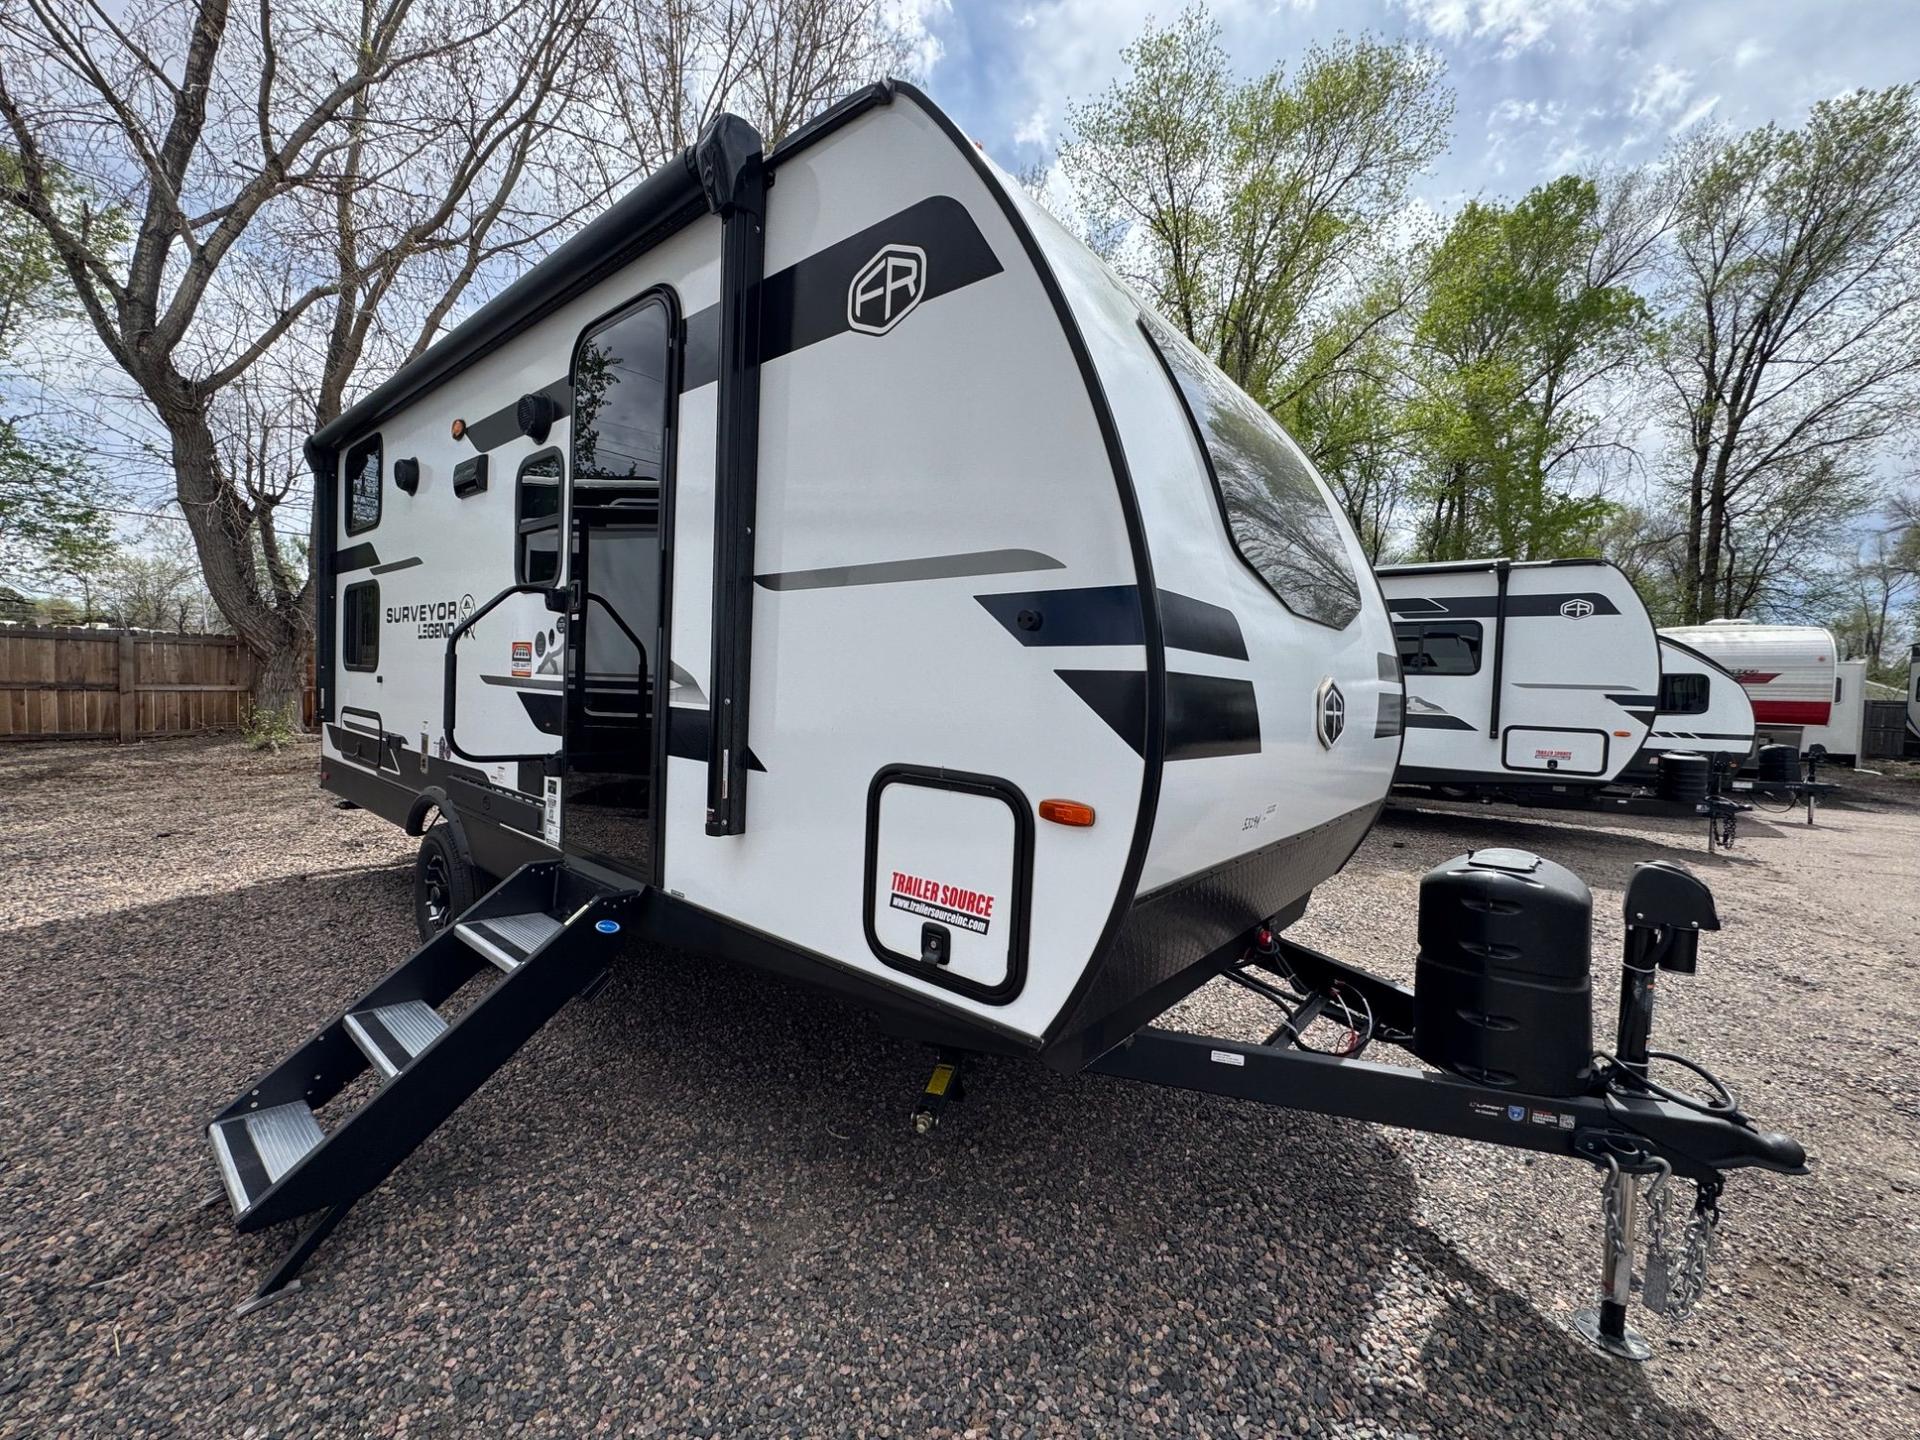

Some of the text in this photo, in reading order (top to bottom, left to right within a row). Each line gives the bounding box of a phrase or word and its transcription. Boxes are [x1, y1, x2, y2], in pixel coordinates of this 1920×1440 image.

[386, 601, 457, 623] SURVEYOR
[417, 622, 455, 639] LEGEND
[891, 871, 995, 917] TRAILER SOURCE
[891, 896, 987, 932] www.trailersourceinc.com
